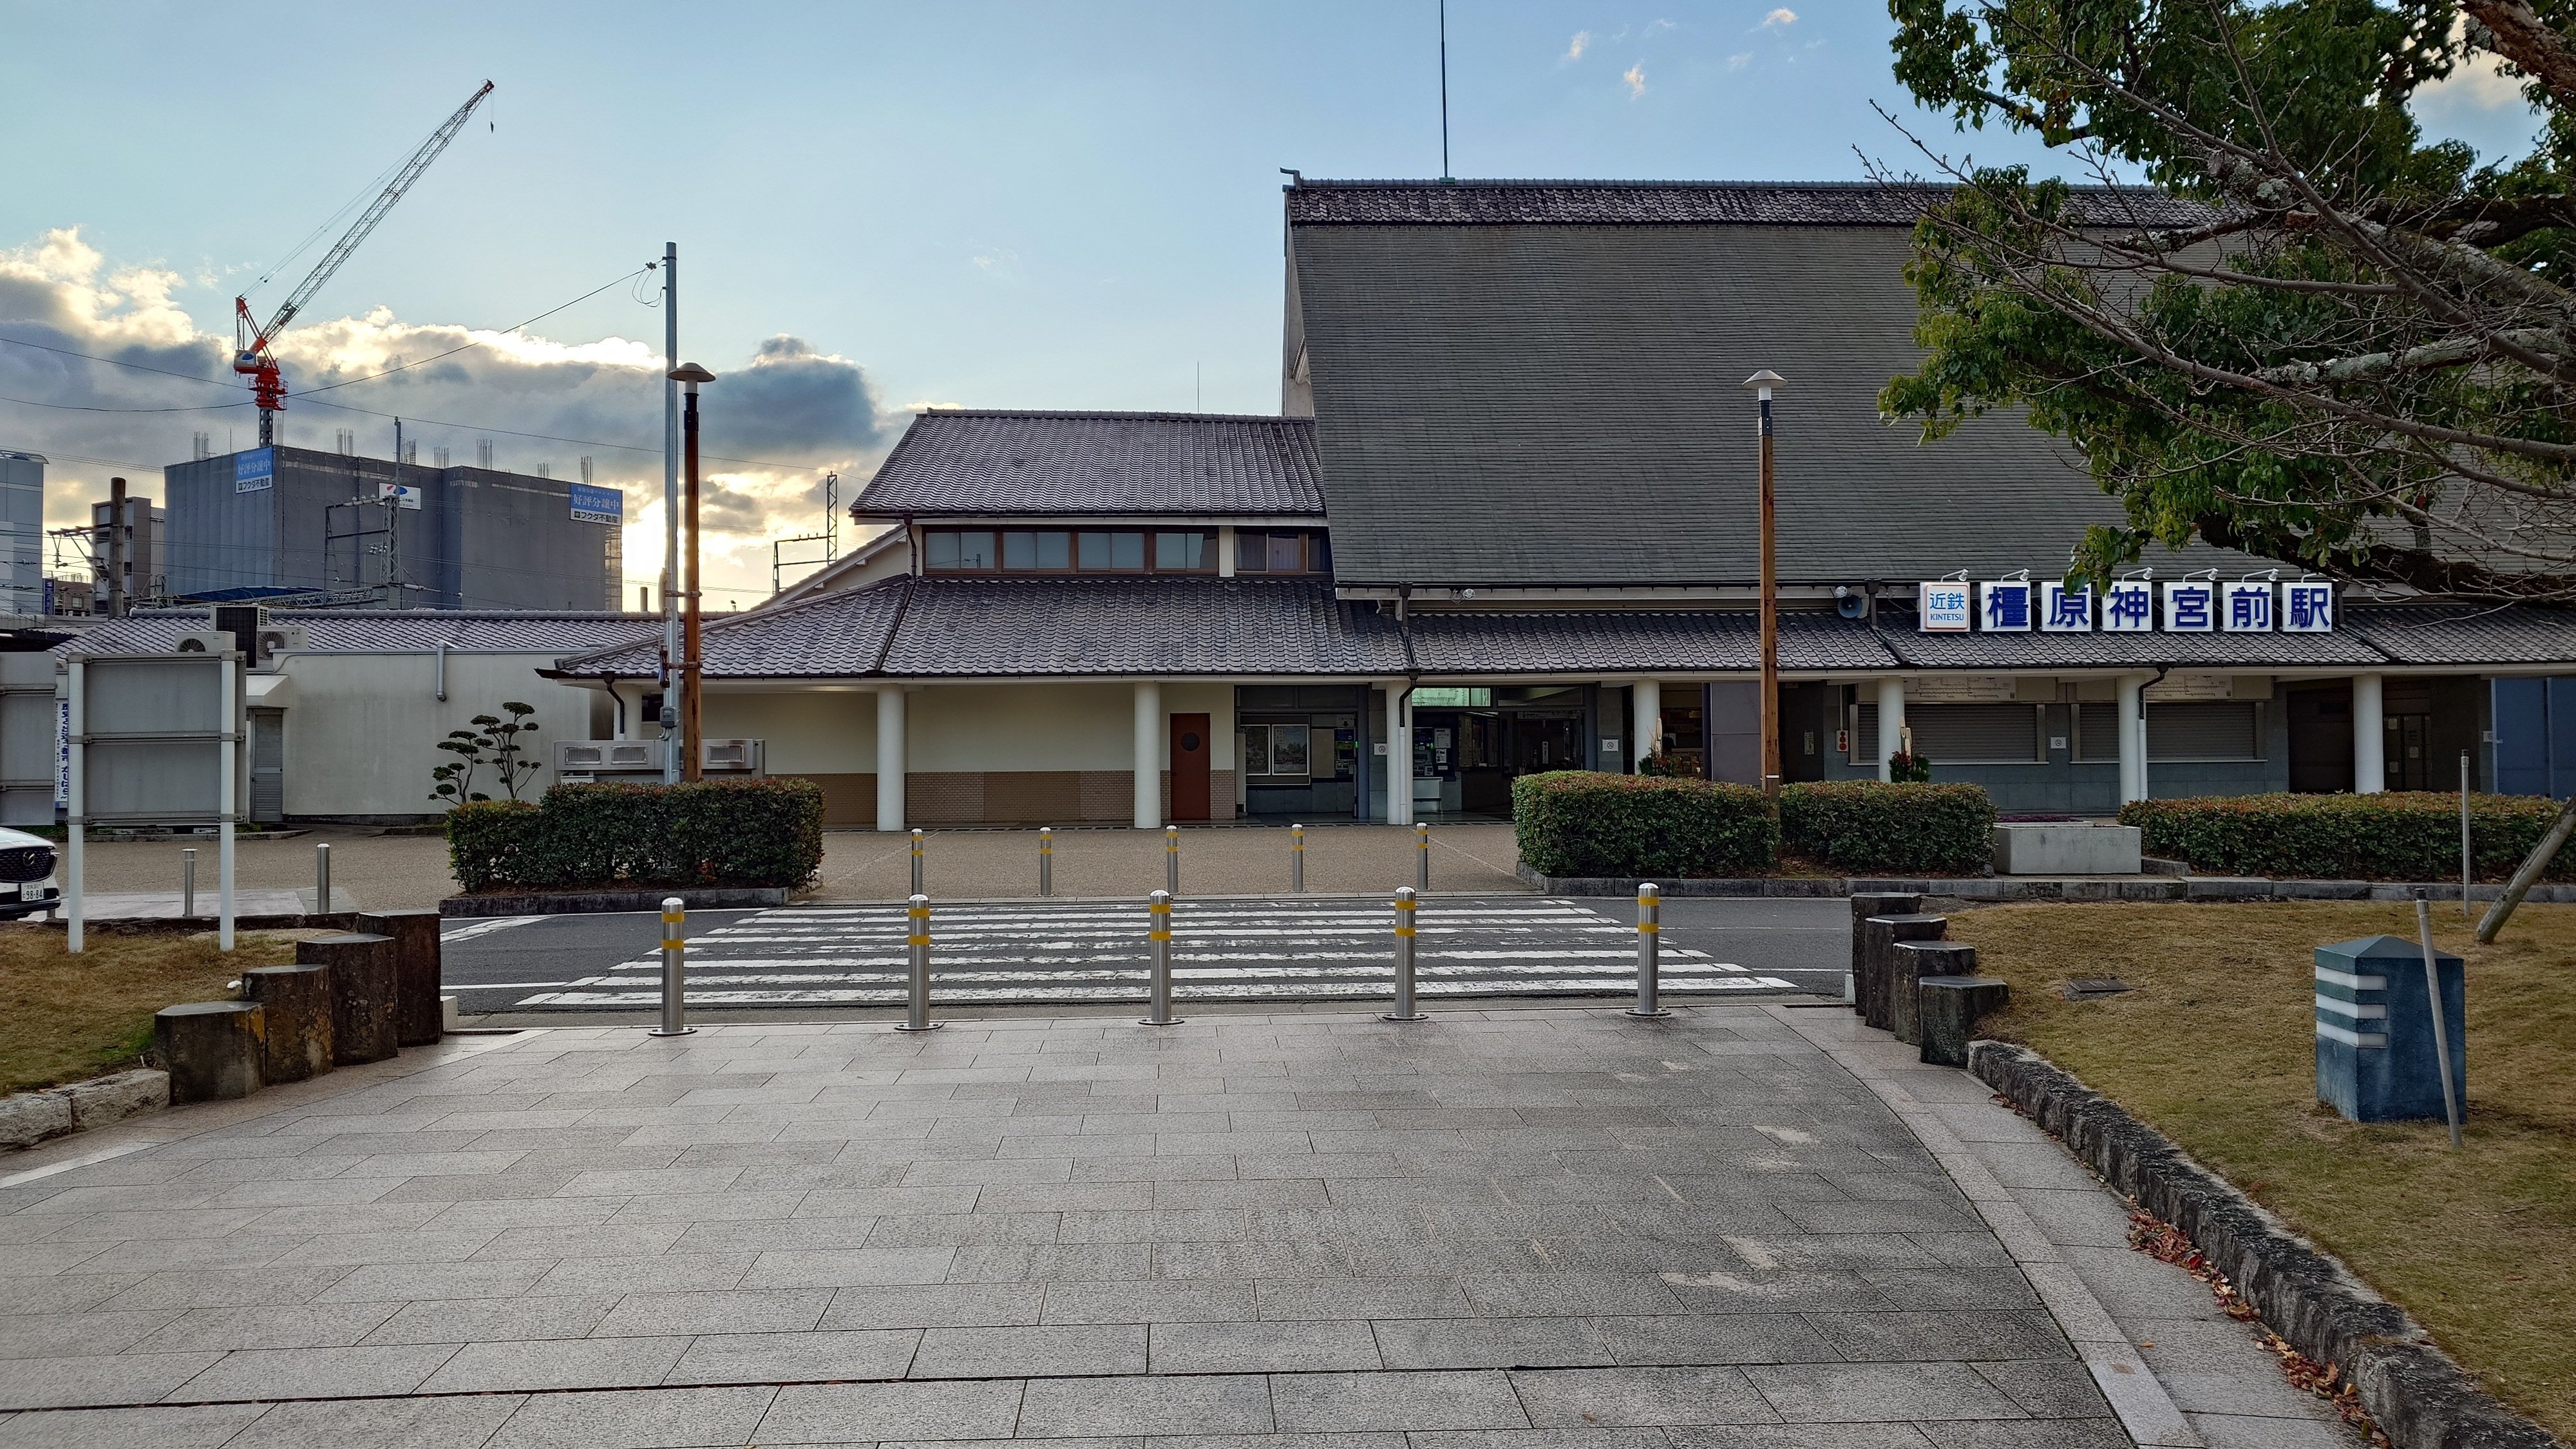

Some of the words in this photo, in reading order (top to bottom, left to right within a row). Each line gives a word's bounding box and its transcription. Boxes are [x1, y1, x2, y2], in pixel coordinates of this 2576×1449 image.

[243, 477, 269, 490] フクダ不動産
[573, 493, 619, 511] 好評分譲中
[581, 511, 618, 524] フクダ不動産
[1929, 592, 1965, 610] 近鉄
[1988, 586, 2330, 629] 橿原神宮前駅
[26, 889, 43, 900] 98-84
